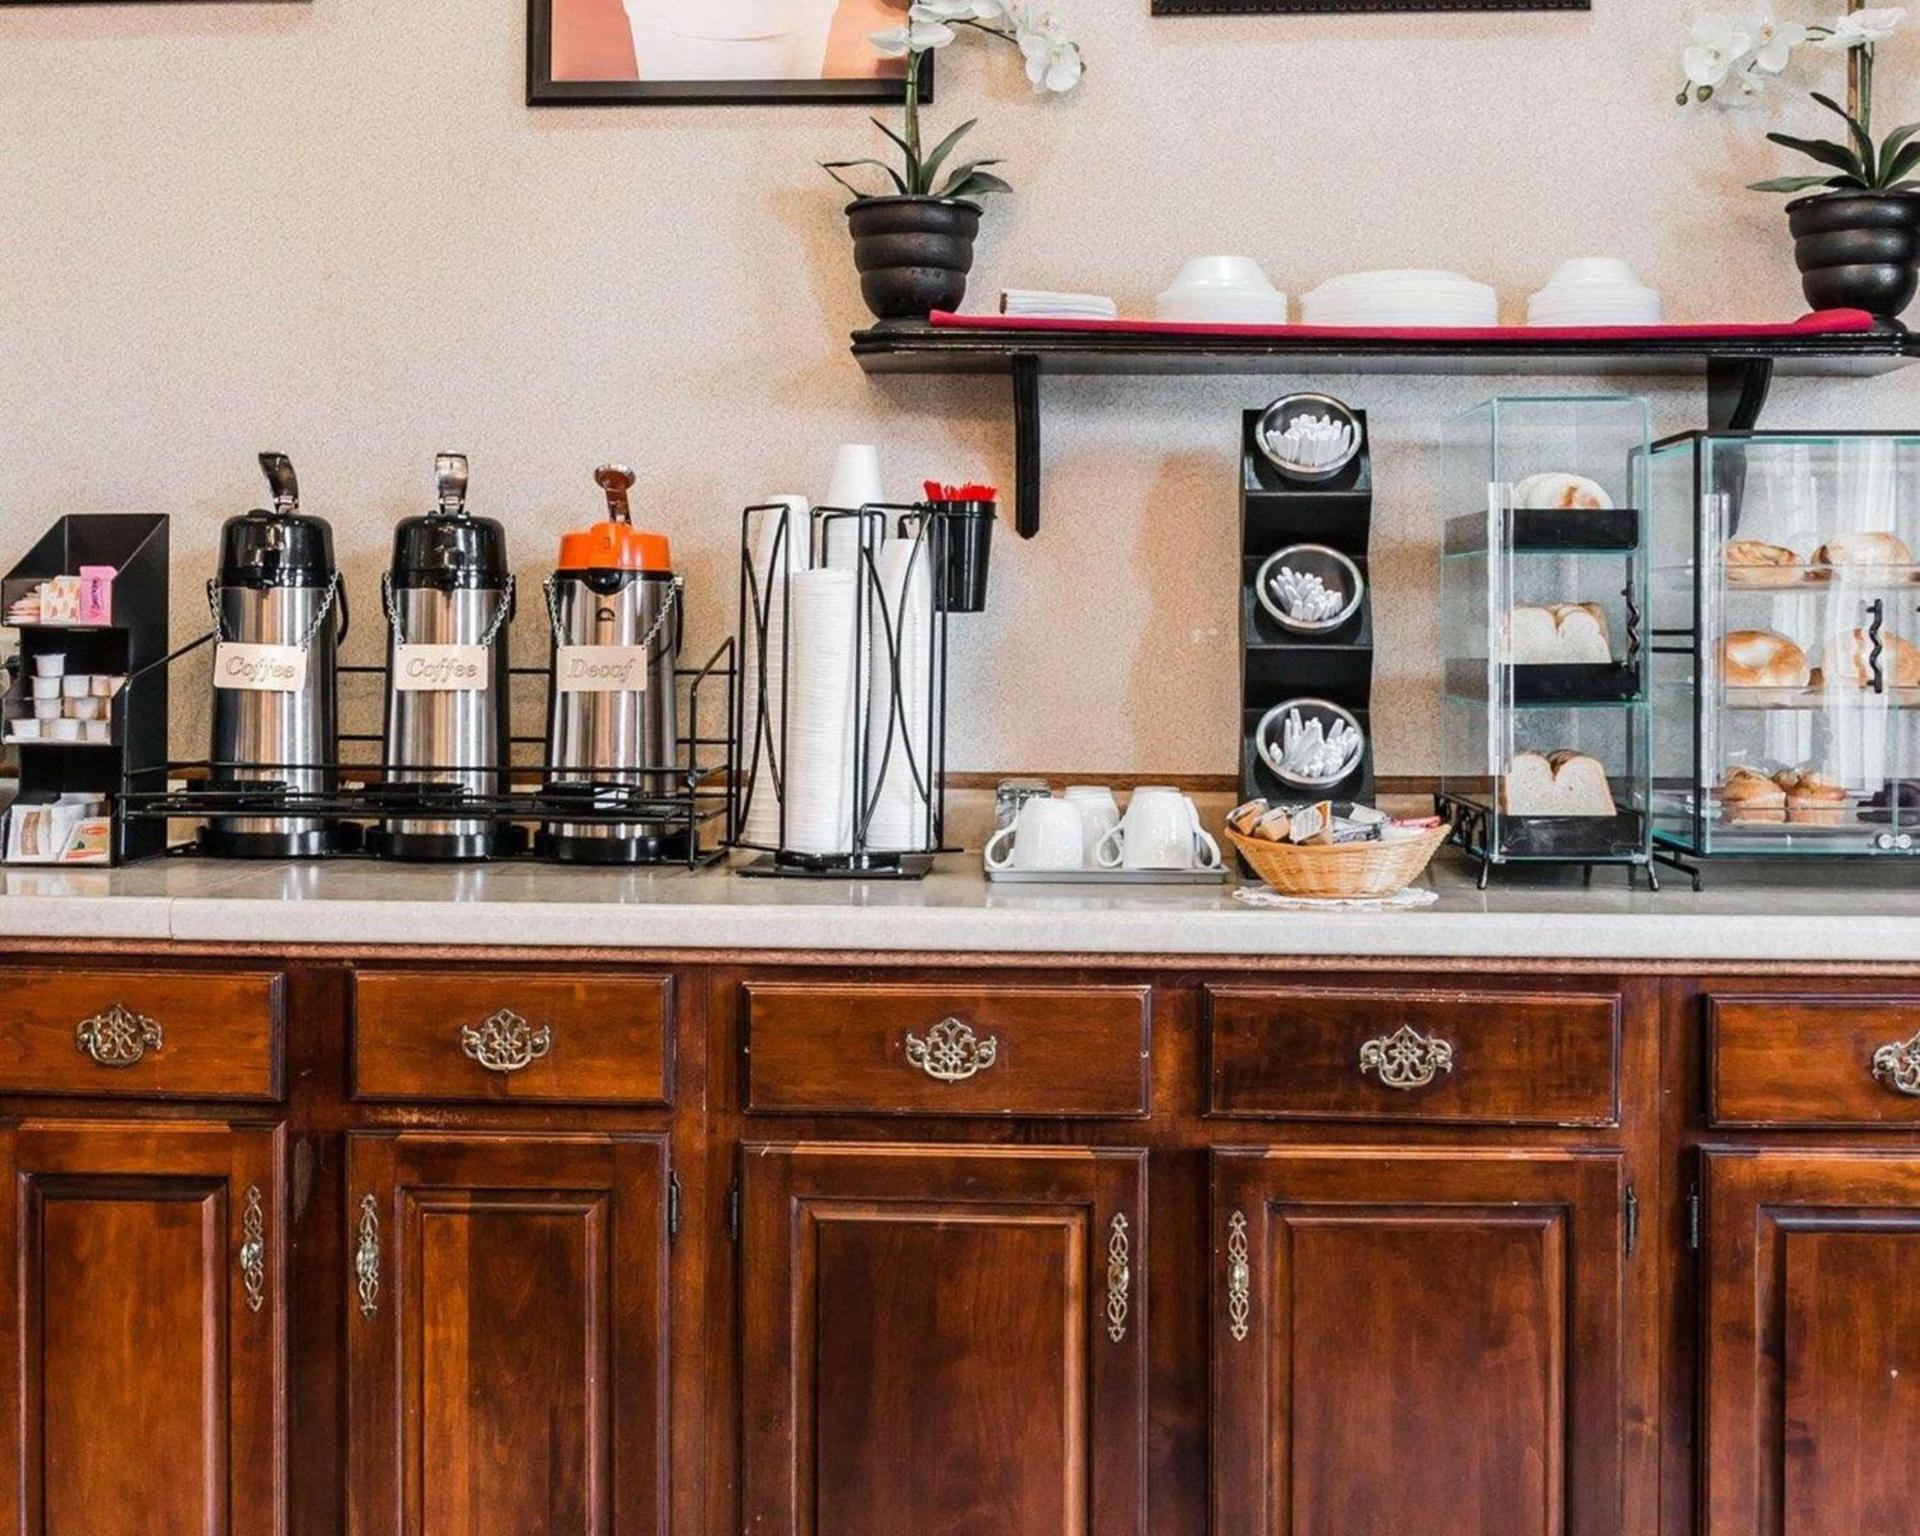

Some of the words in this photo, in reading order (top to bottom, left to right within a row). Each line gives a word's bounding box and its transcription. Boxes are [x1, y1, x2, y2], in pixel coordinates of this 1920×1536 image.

[226, 656, 295, 682] Coffee
[406, 658, 477, 683] Coffee
[566, 658, 637, 683] Decaf
